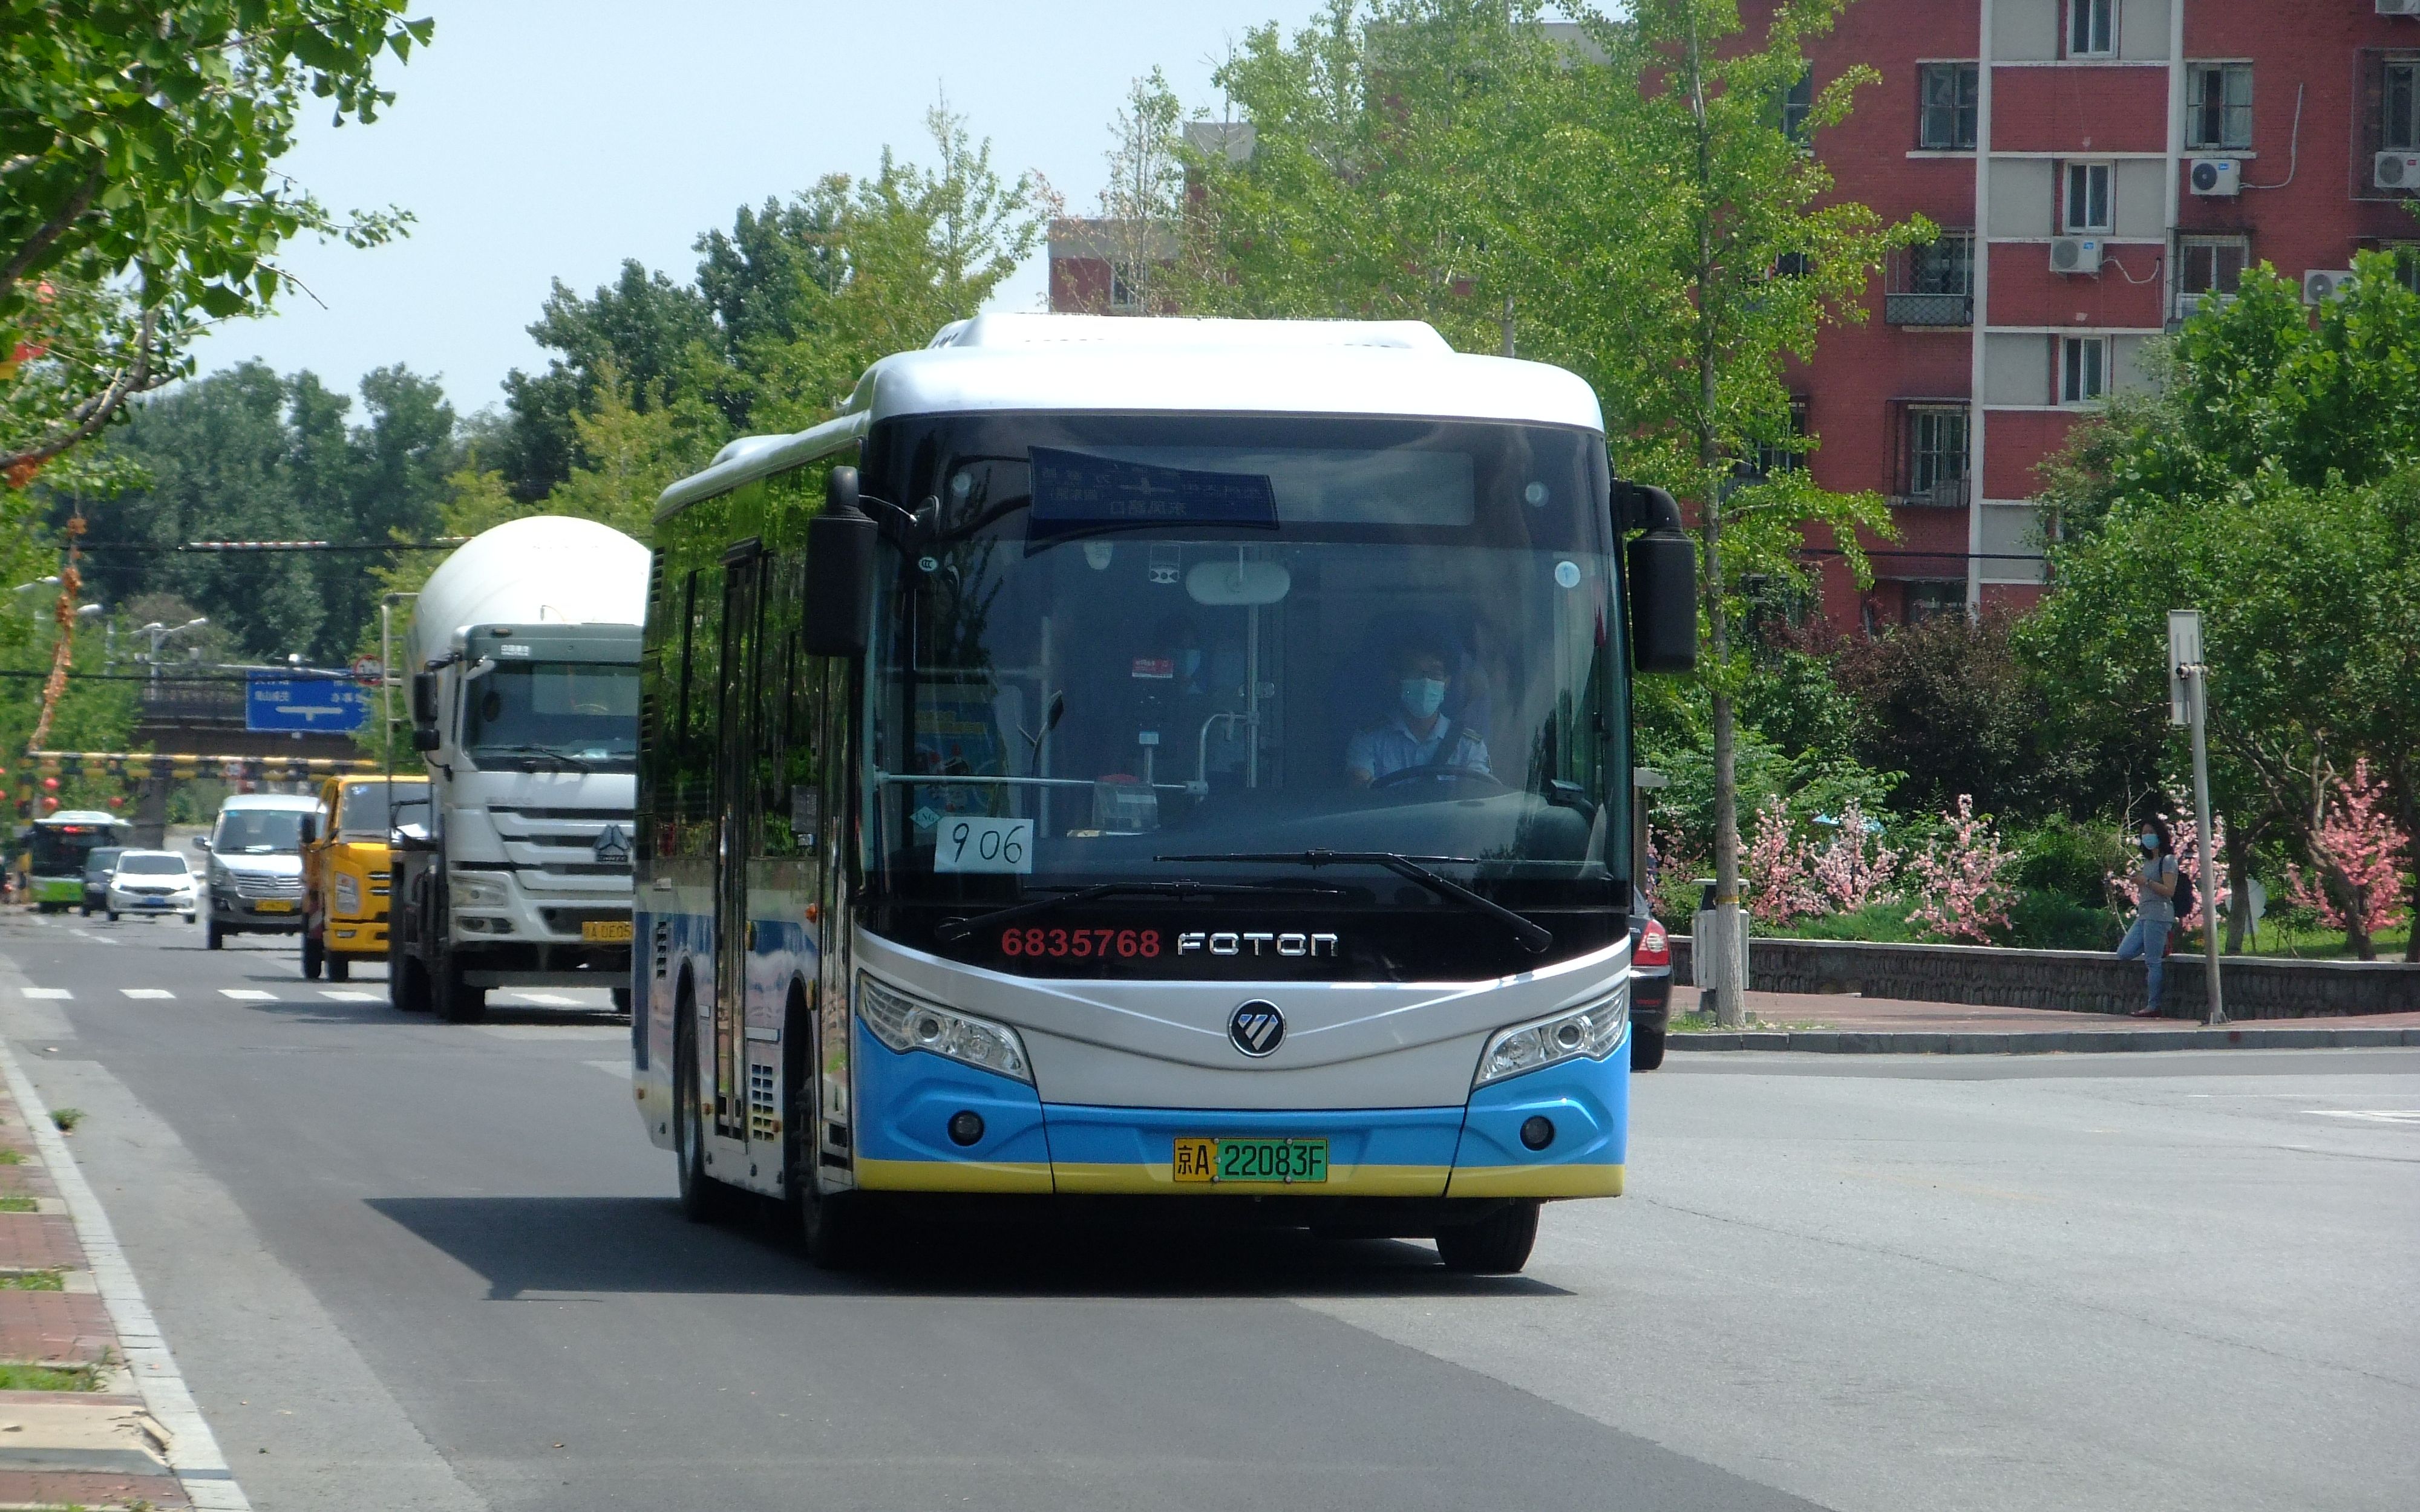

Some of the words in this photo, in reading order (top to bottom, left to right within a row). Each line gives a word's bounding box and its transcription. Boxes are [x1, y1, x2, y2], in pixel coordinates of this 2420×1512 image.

[953, 823, 1025, 864] 906
[1002, 928, 1160, 957] 6835768
[1178, 932, 1339, 957] FOTON
